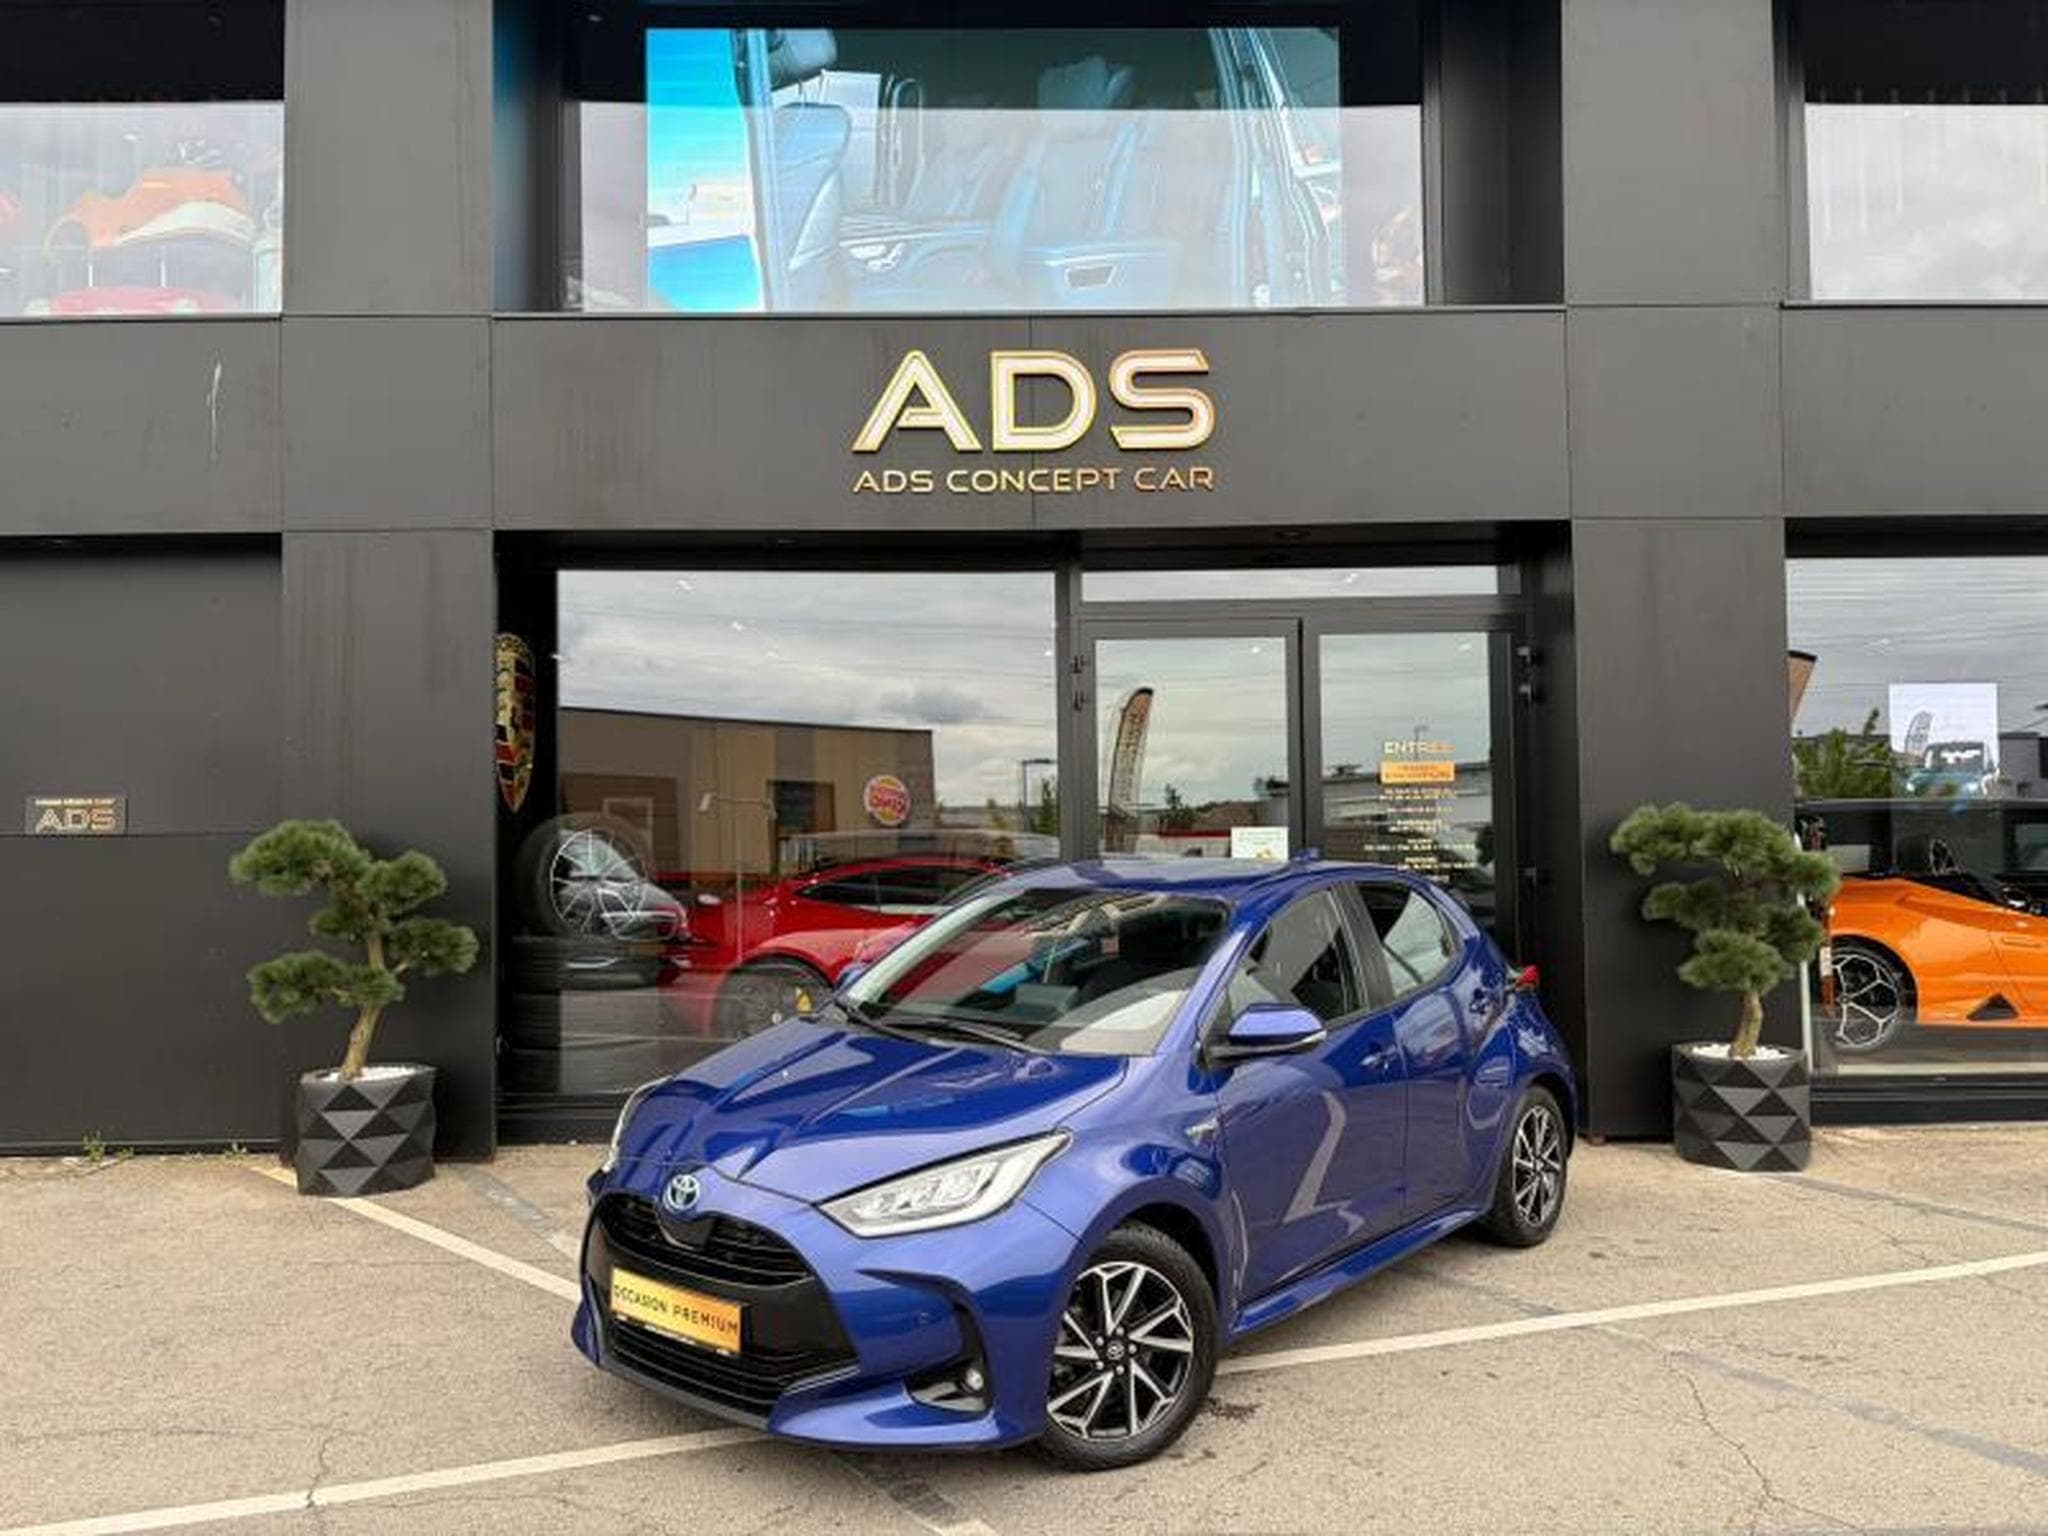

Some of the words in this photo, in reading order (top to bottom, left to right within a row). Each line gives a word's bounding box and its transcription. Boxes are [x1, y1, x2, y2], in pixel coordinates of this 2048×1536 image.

[851, 349, 1216, 451] ADS
[852, 469, 935, 494] ADS
[946, 466, 1123, 494] CONCEPT
[1133, 466, 1215, 492] CAR
[35, 808, 117, 835] ADS
[613, 1284, 668, 1312] OCCASION
[673, 1304, 738, 1335] PREMIUM
